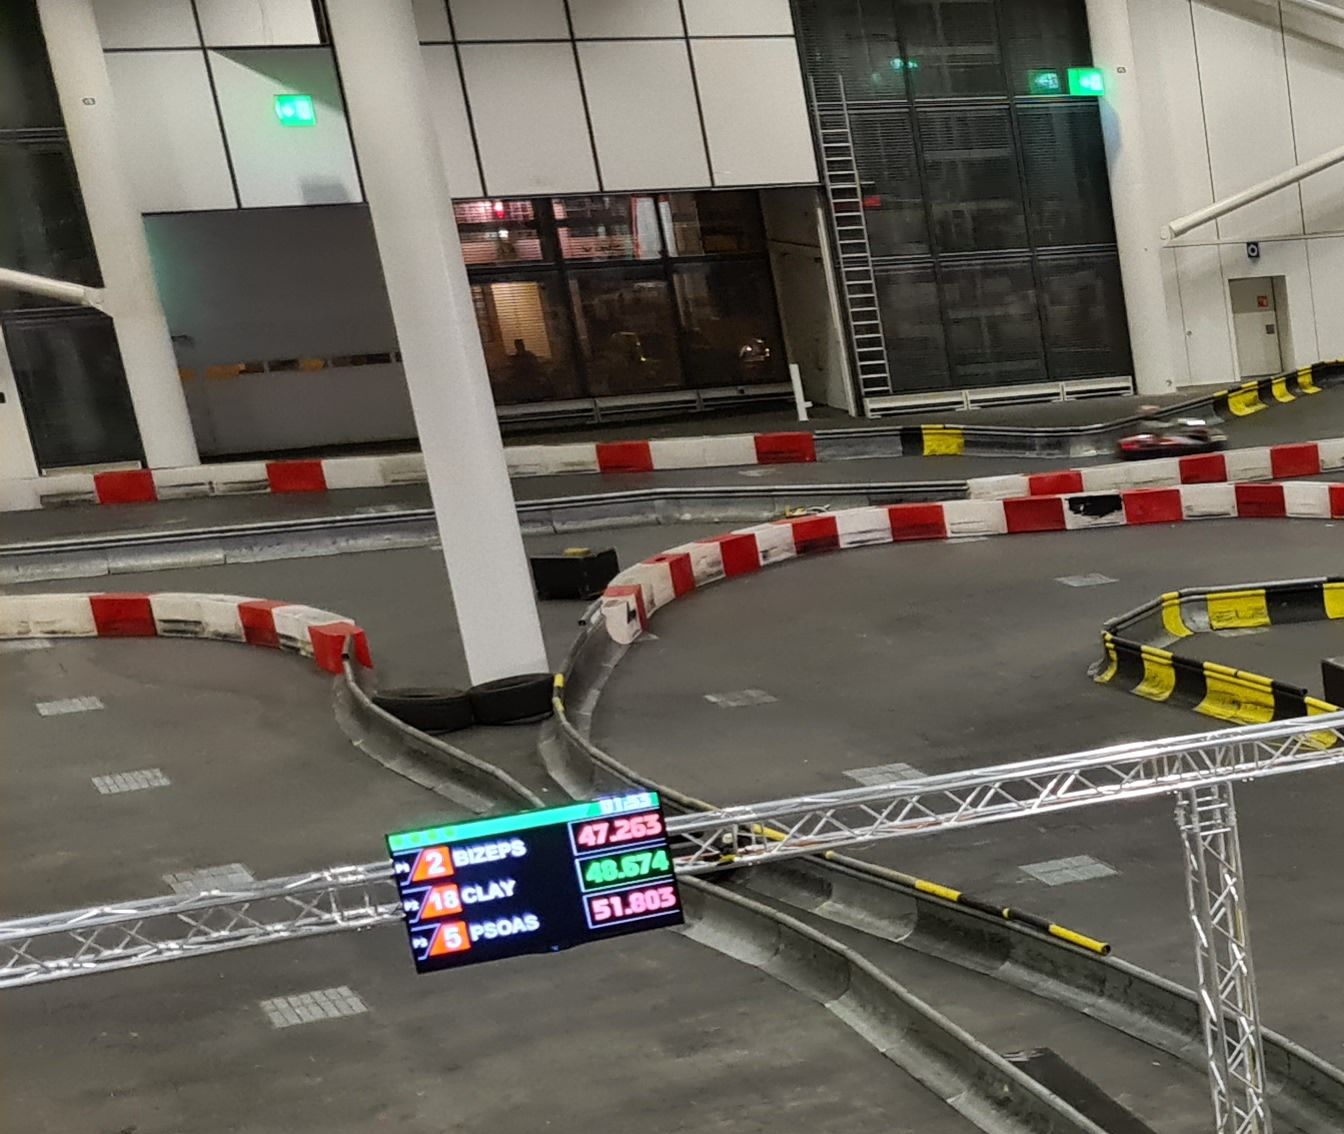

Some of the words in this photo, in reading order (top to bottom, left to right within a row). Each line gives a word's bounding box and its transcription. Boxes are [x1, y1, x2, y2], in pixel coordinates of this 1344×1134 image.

[425, 851, 446, 875] 2
[452, 838, 527, 867] BIZEPS
[578, 813, 662, 847] 47.263
[429, 889, 458, 911] 18
[461, 878, 517, 904] CLAY
[443, 926, 462, 948] 5
[469, 914, 540, 942] PSOAS
[591, 886, 676, 921] 51.803
